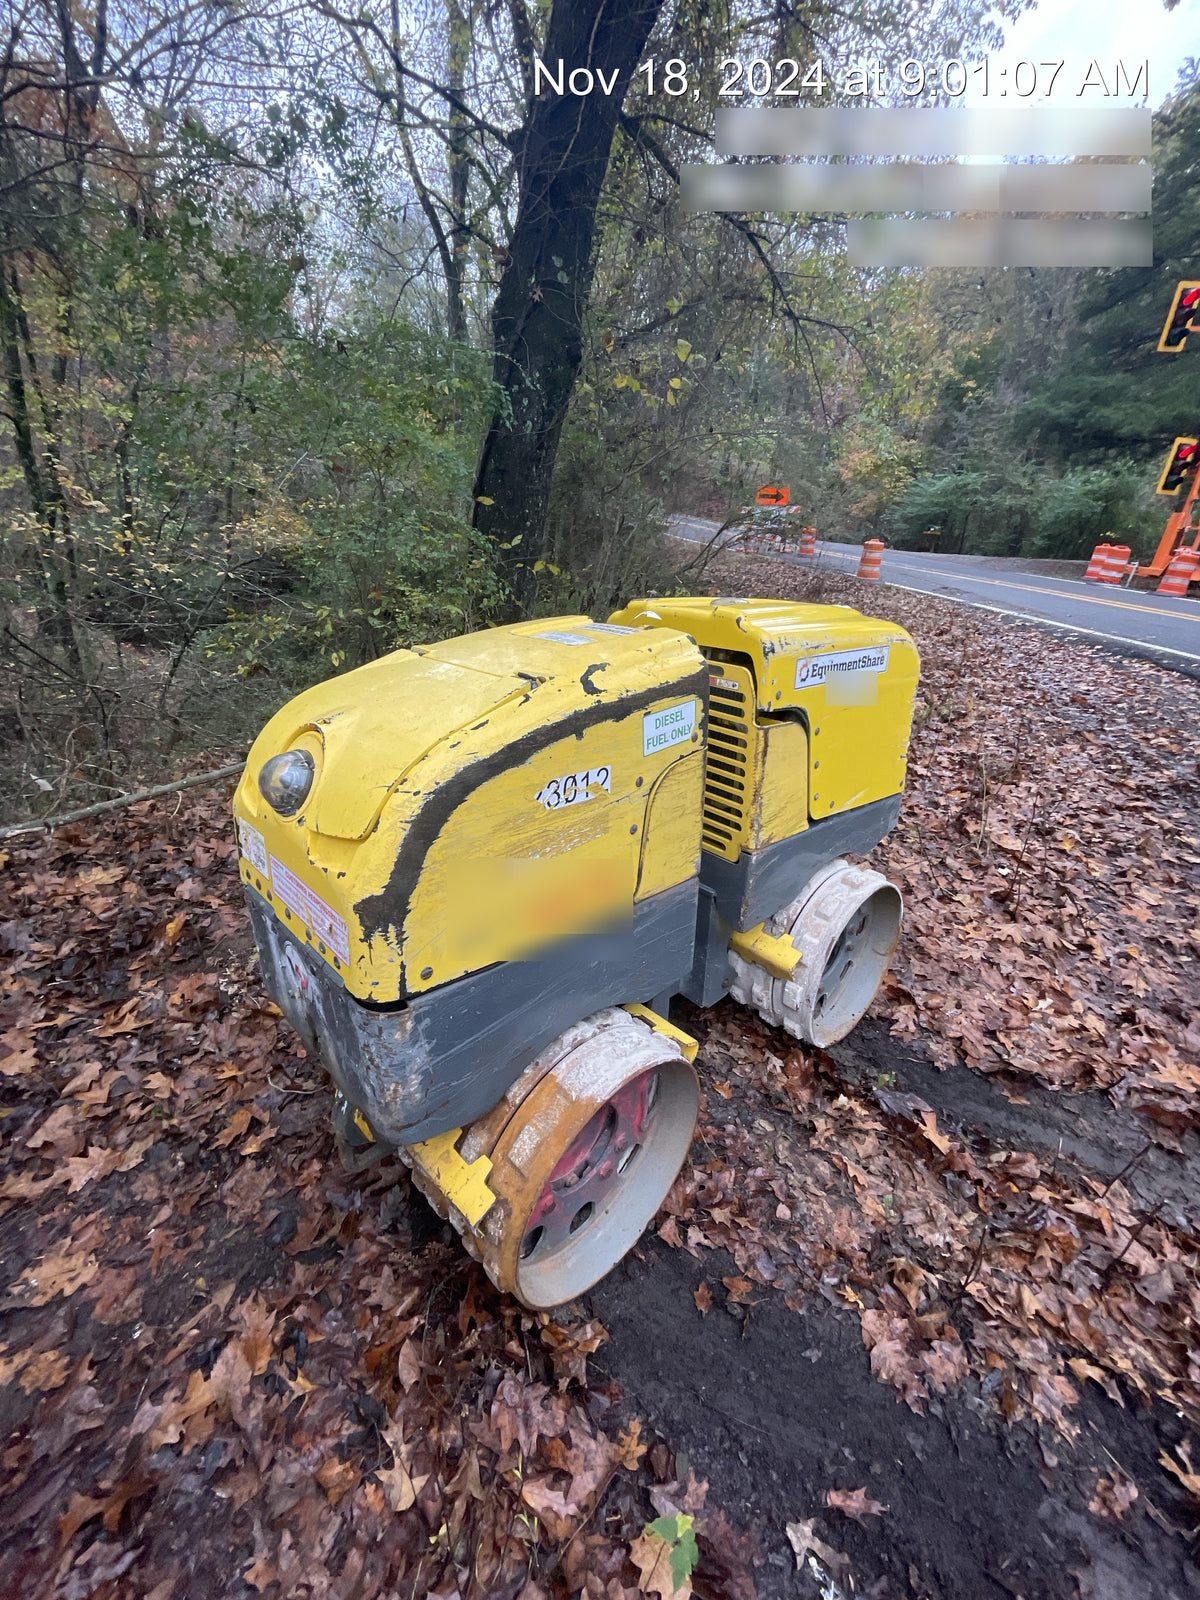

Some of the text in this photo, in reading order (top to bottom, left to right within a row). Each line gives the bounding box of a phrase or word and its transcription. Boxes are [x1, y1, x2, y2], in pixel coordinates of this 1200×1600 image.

[655, 710, 685, 729] DIESEL
[646, 722, 692, 750] FUEL ONLY
